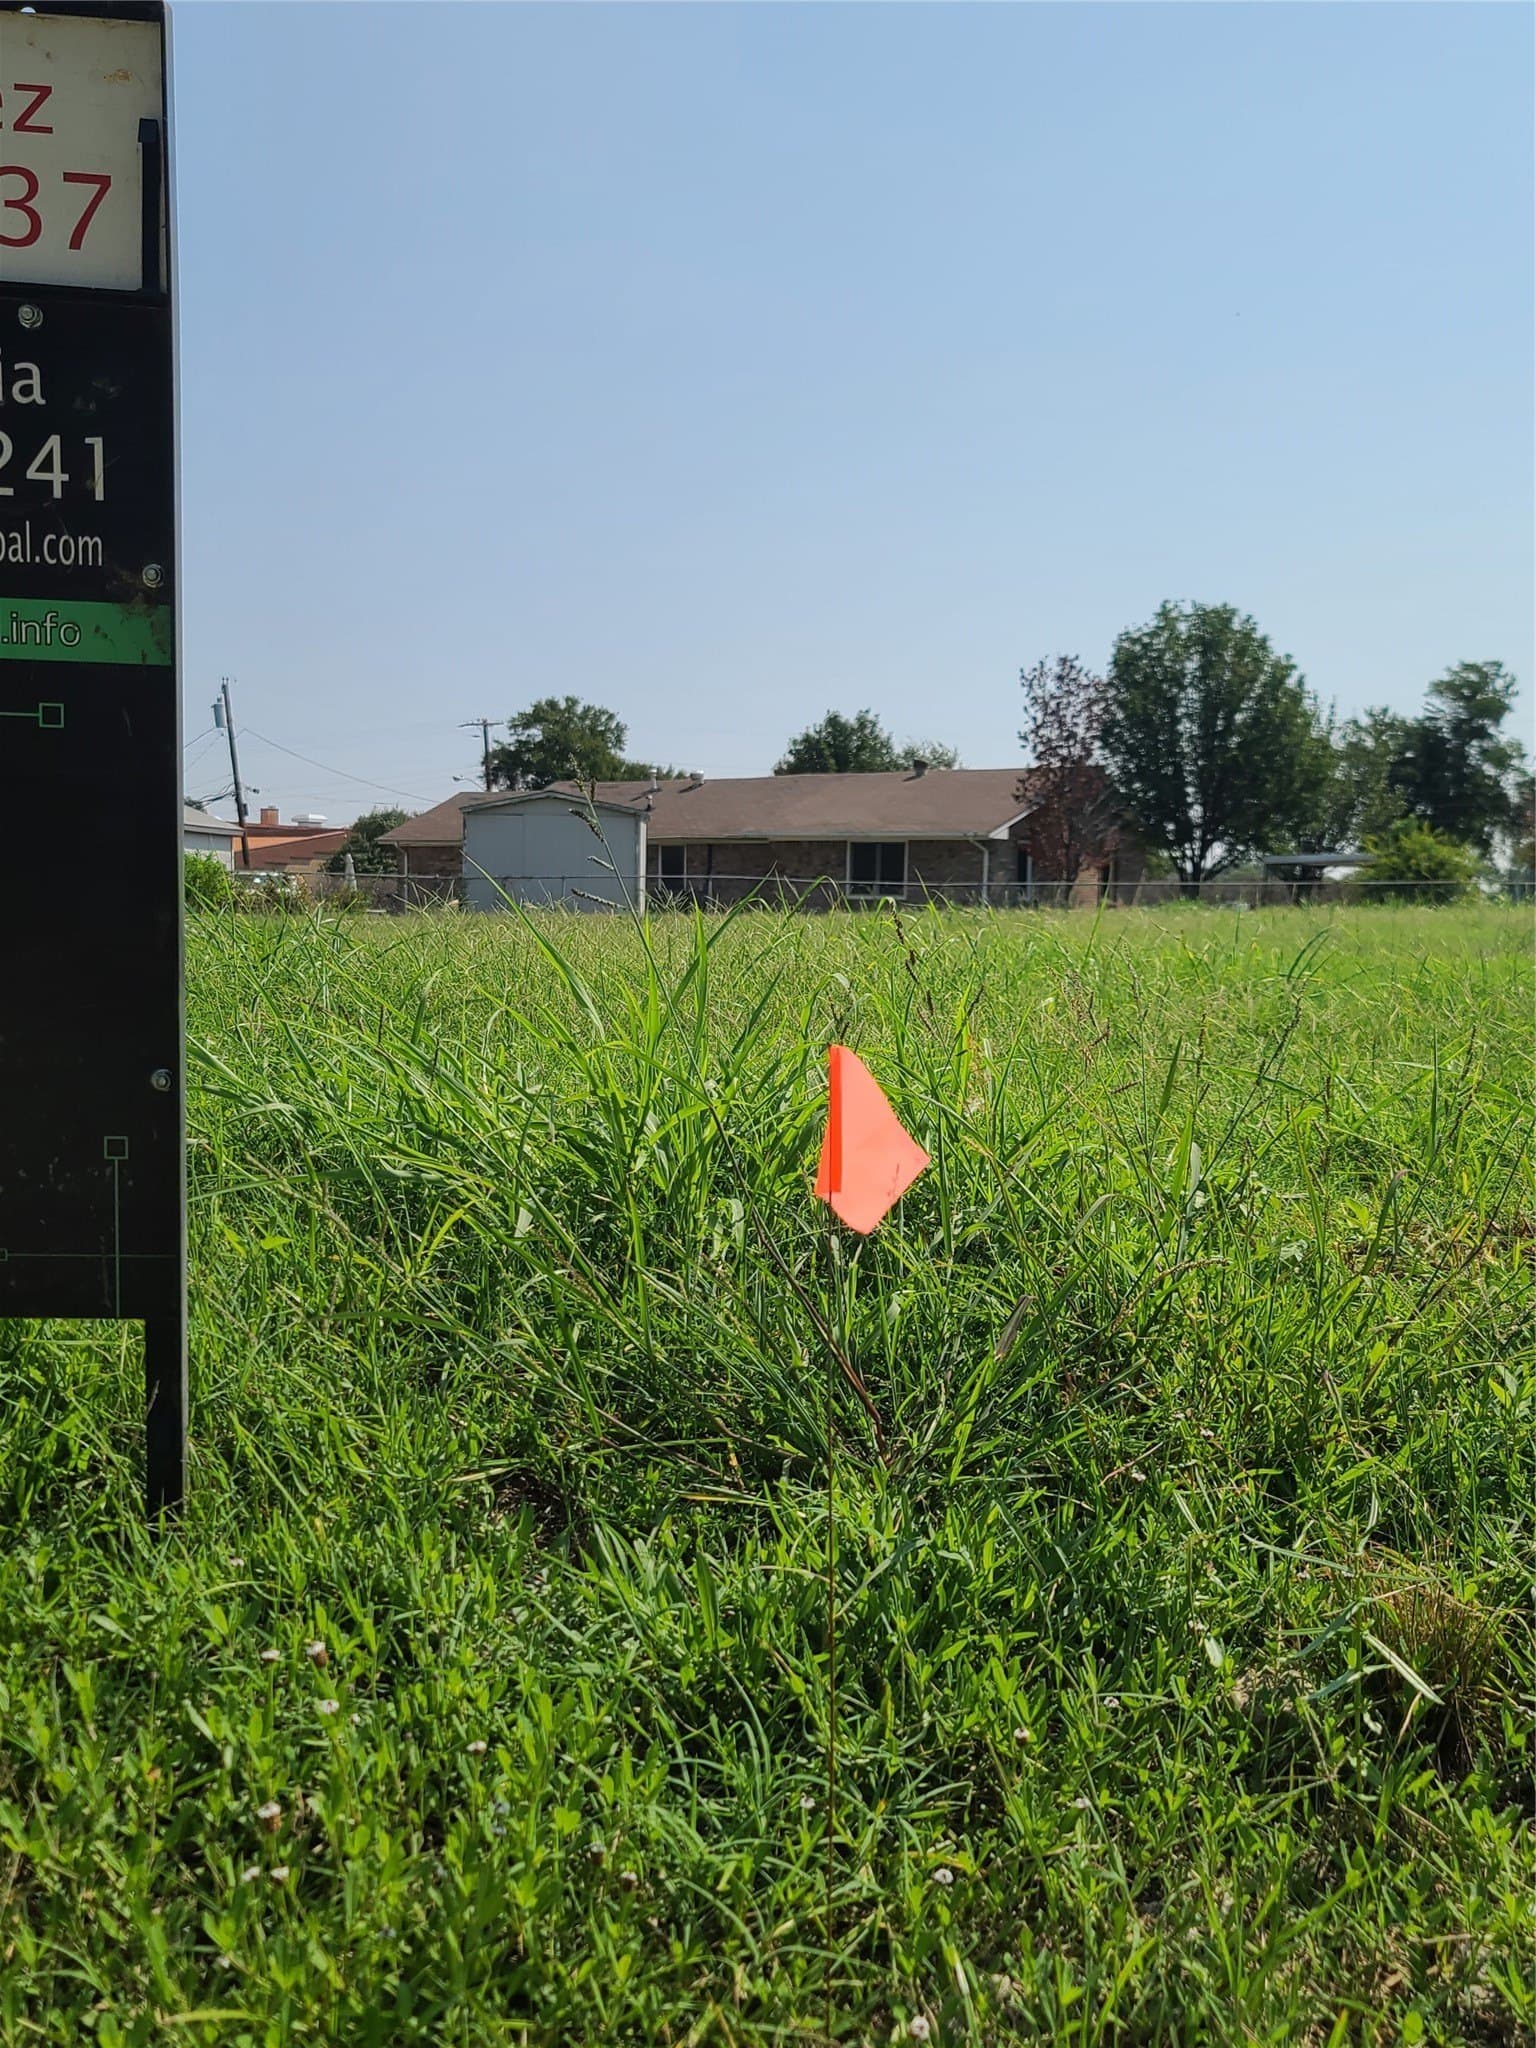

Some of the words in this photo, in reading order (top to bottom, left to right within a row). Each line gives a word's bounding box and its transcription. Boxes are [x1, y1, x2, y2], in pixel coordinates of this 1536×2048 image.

[0, 83, 53, 134] z
[0, 166, 111, 250] 37
[3, 612, 80, 646] .info
